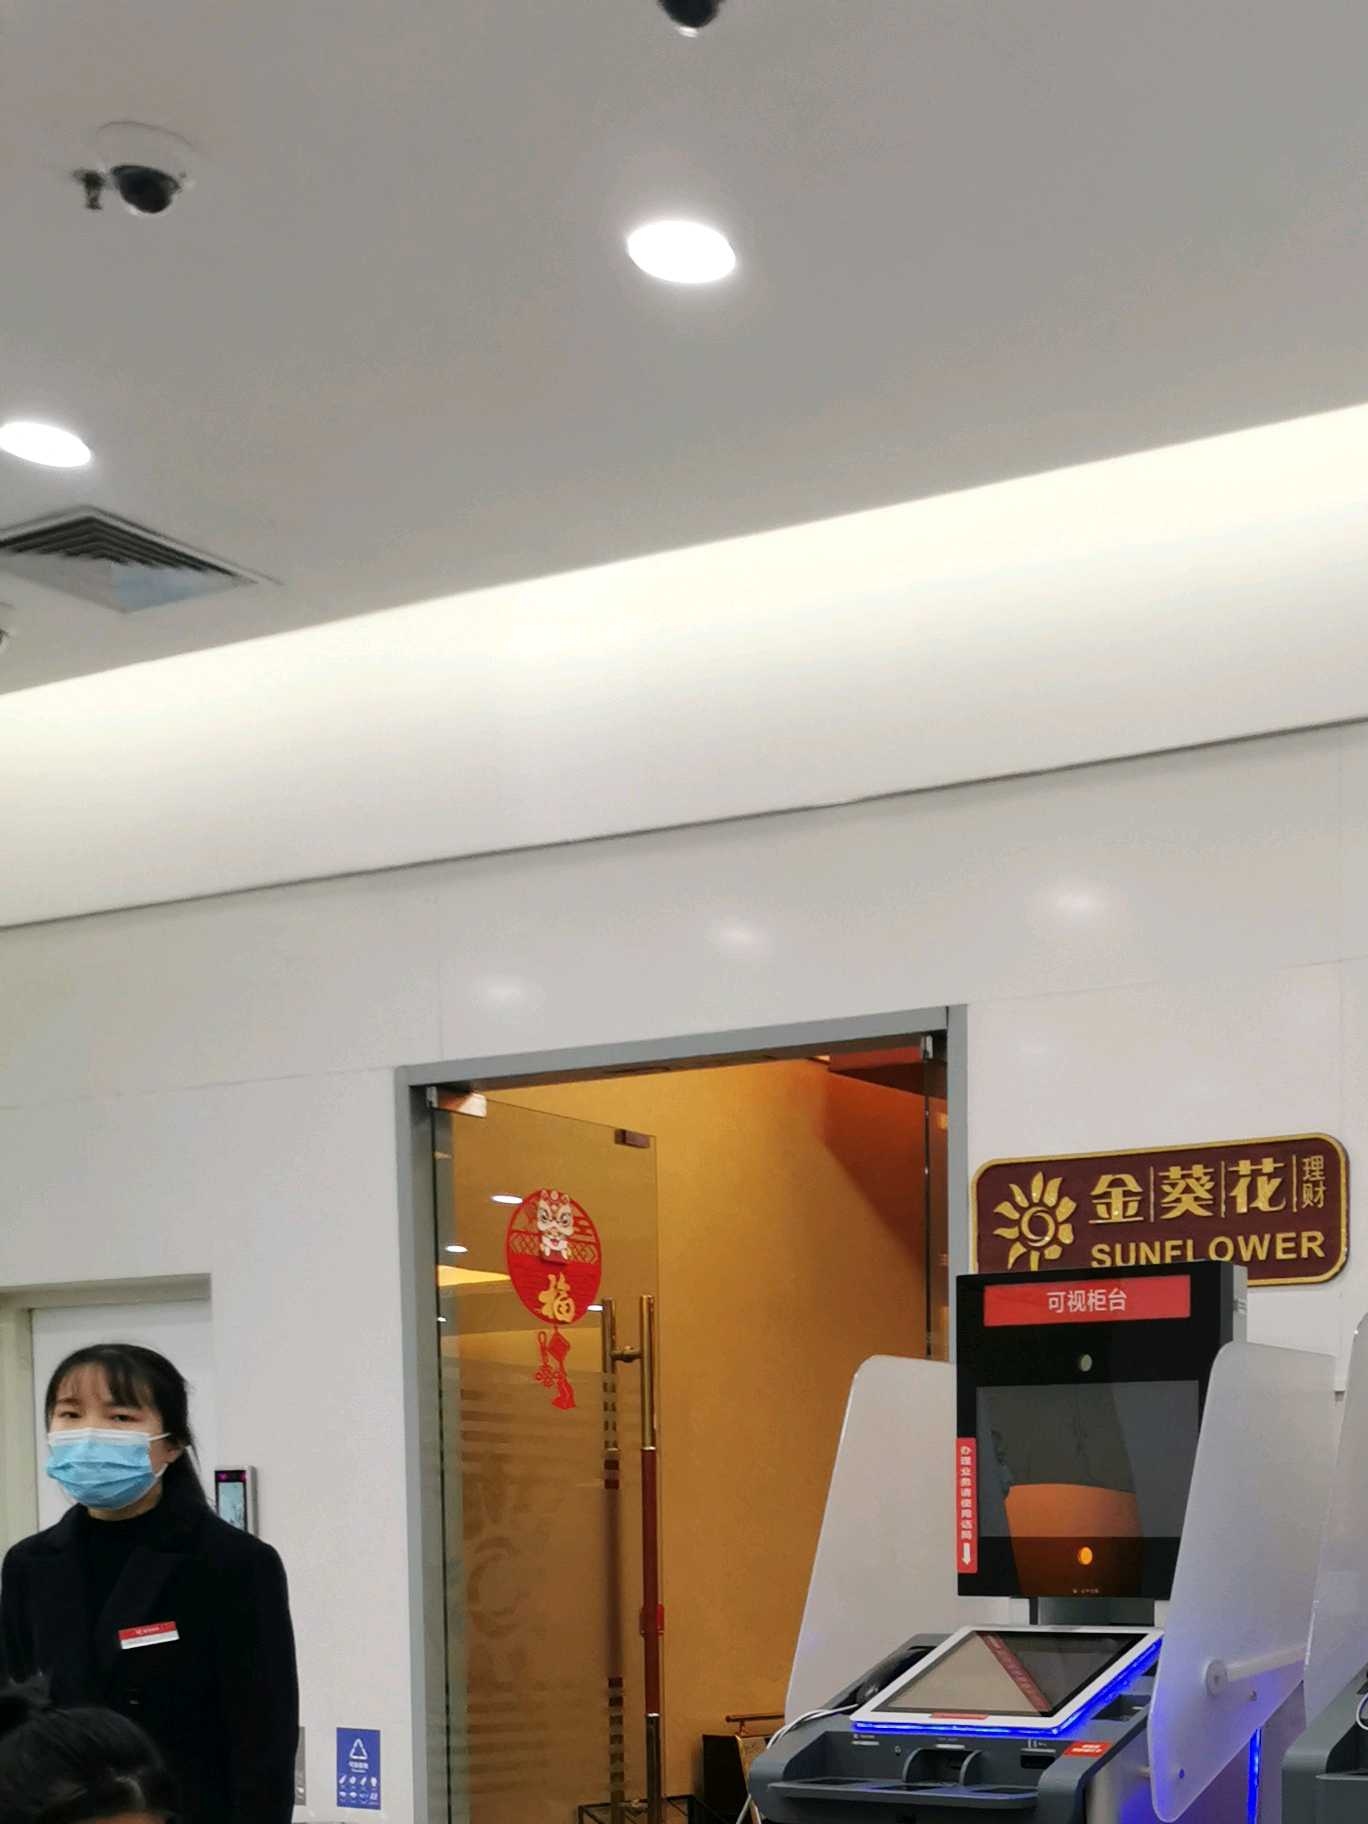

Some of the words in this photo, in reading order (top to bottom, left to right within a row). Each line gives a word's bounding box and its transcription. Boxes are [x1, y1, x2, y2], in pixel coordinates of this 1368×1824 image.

[1089, 1157, 1285, 1224] 金葵花
[1302, 1155, 1326, 1209] 理财
[1090, 1230, 1326, 1269] SUNFLOWER
[1046, 1287, 1128, 1313] 可视柜台
